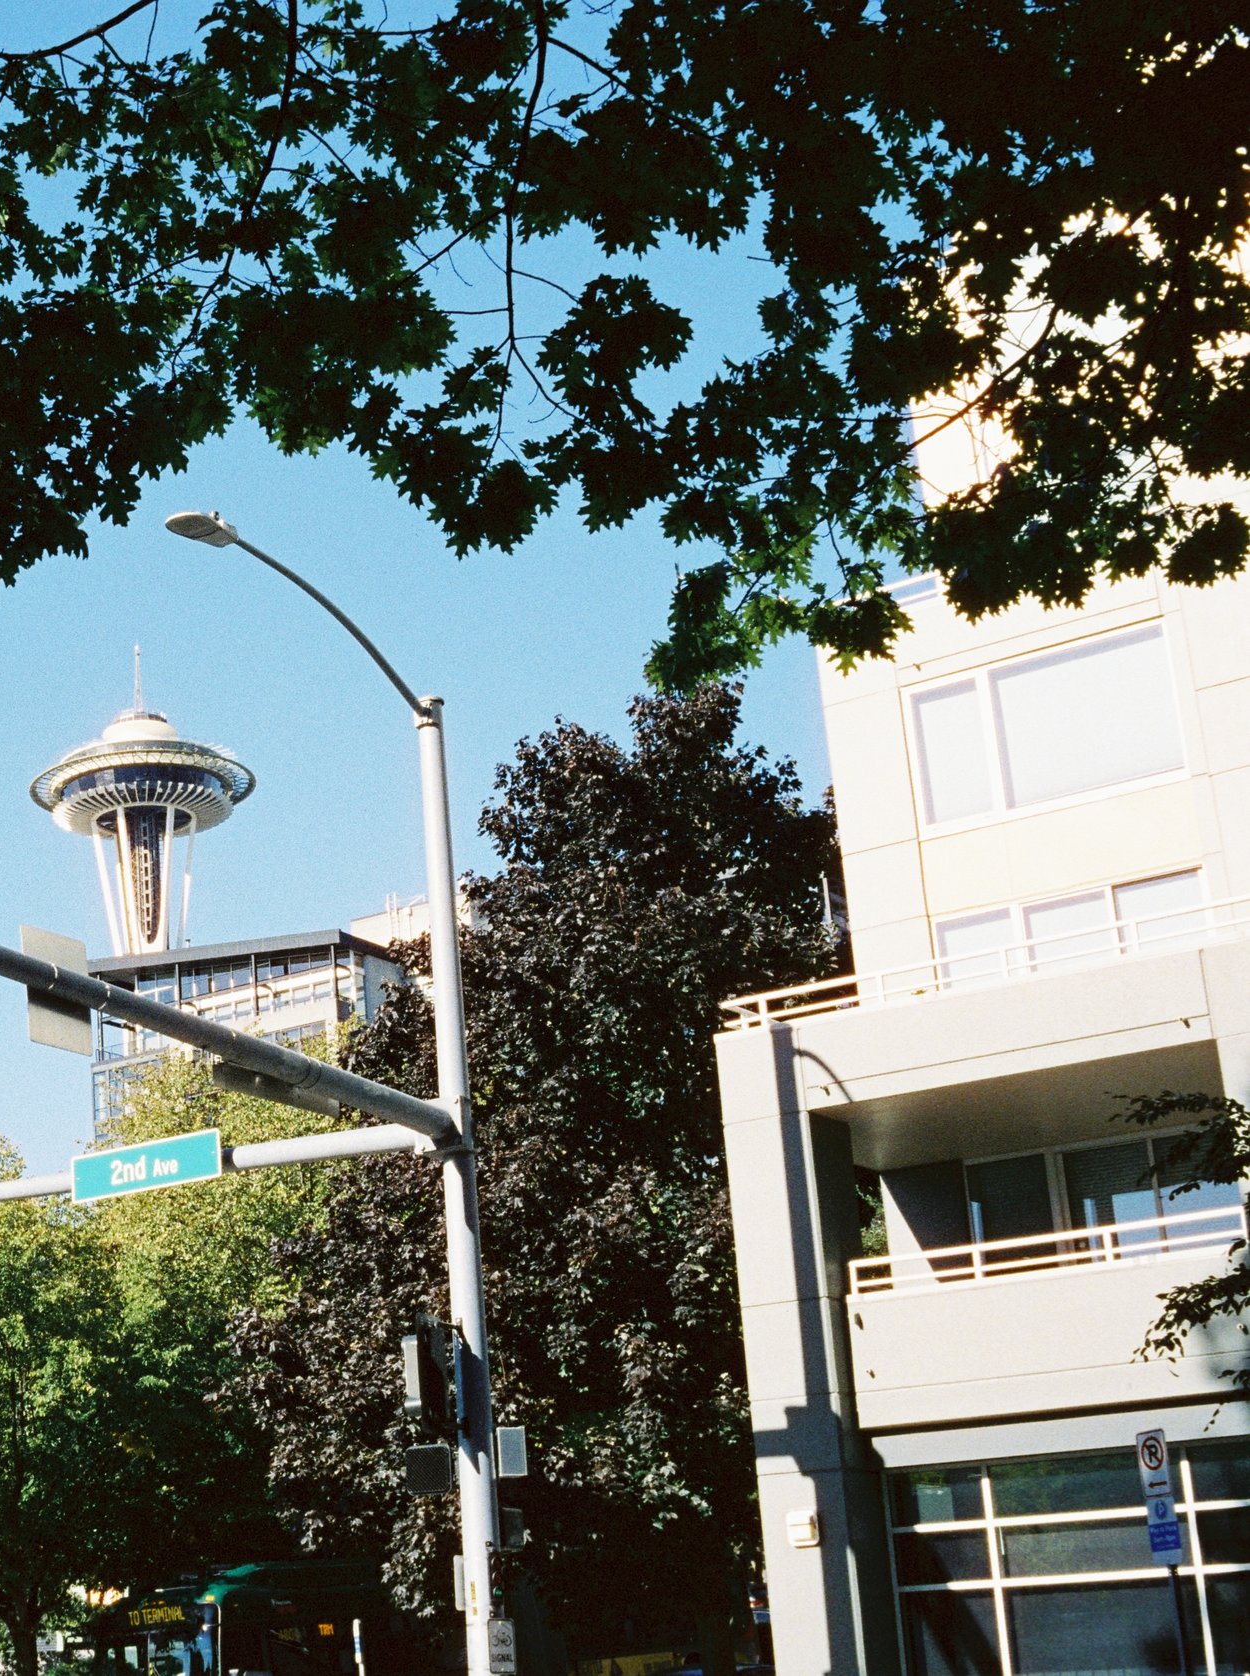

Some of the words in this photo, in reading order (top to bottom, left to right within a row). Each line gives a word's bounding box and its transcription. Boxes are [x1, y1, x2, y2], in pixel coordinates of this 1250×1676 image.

[110, 1155, 147, 1186] 2nd
[152, 1158, 179, 1178] Ave
[128, 1610, 141, 1627] TO
[141, 1605, 187, 1626] TERMINAL
[491, 1652, 514, 1663] SIGNAL
